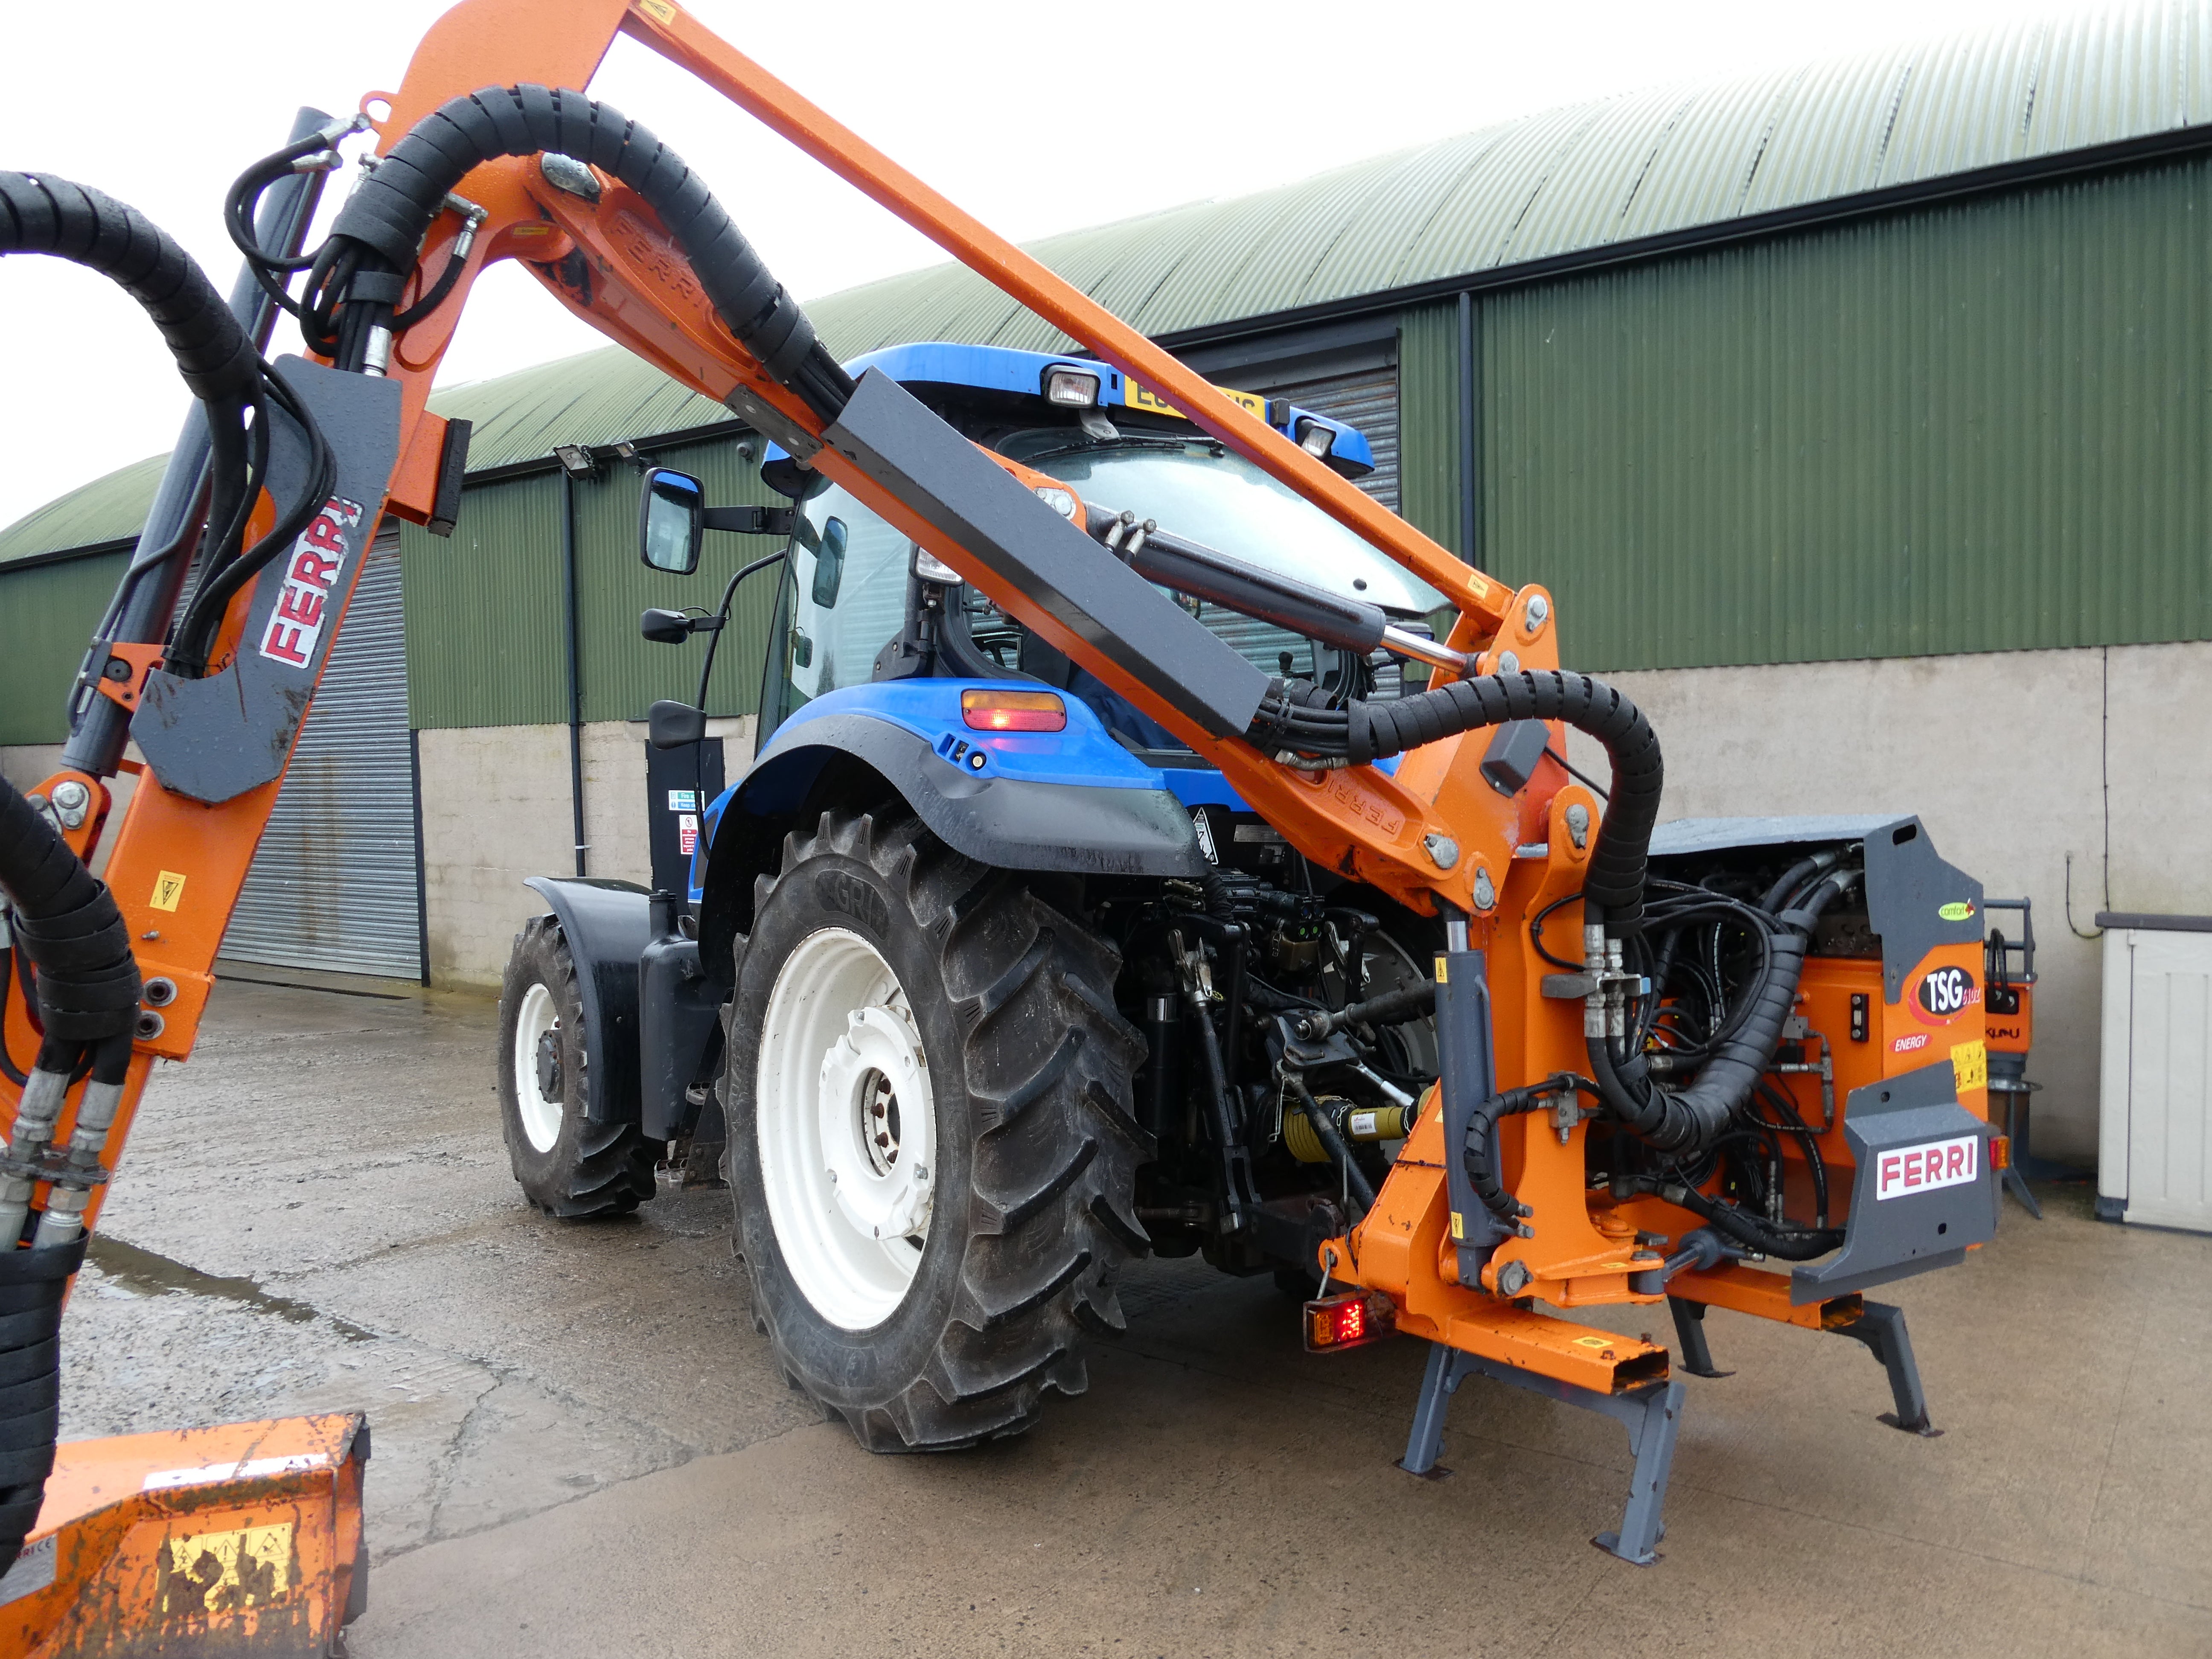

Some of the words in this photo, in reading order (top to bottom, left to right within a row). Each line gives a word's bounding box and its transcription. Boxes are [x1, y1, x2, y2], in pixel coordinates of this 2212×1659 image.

[1328, 779, 1399, 835] FERRI
[1941, 905, 1965, 916] comfort
[1927, 969, 1962, 1012] TSG
[1895, 1034, 1927, 1052] ENERGY
[1882, 1142, 1973, 1192] FERRI
